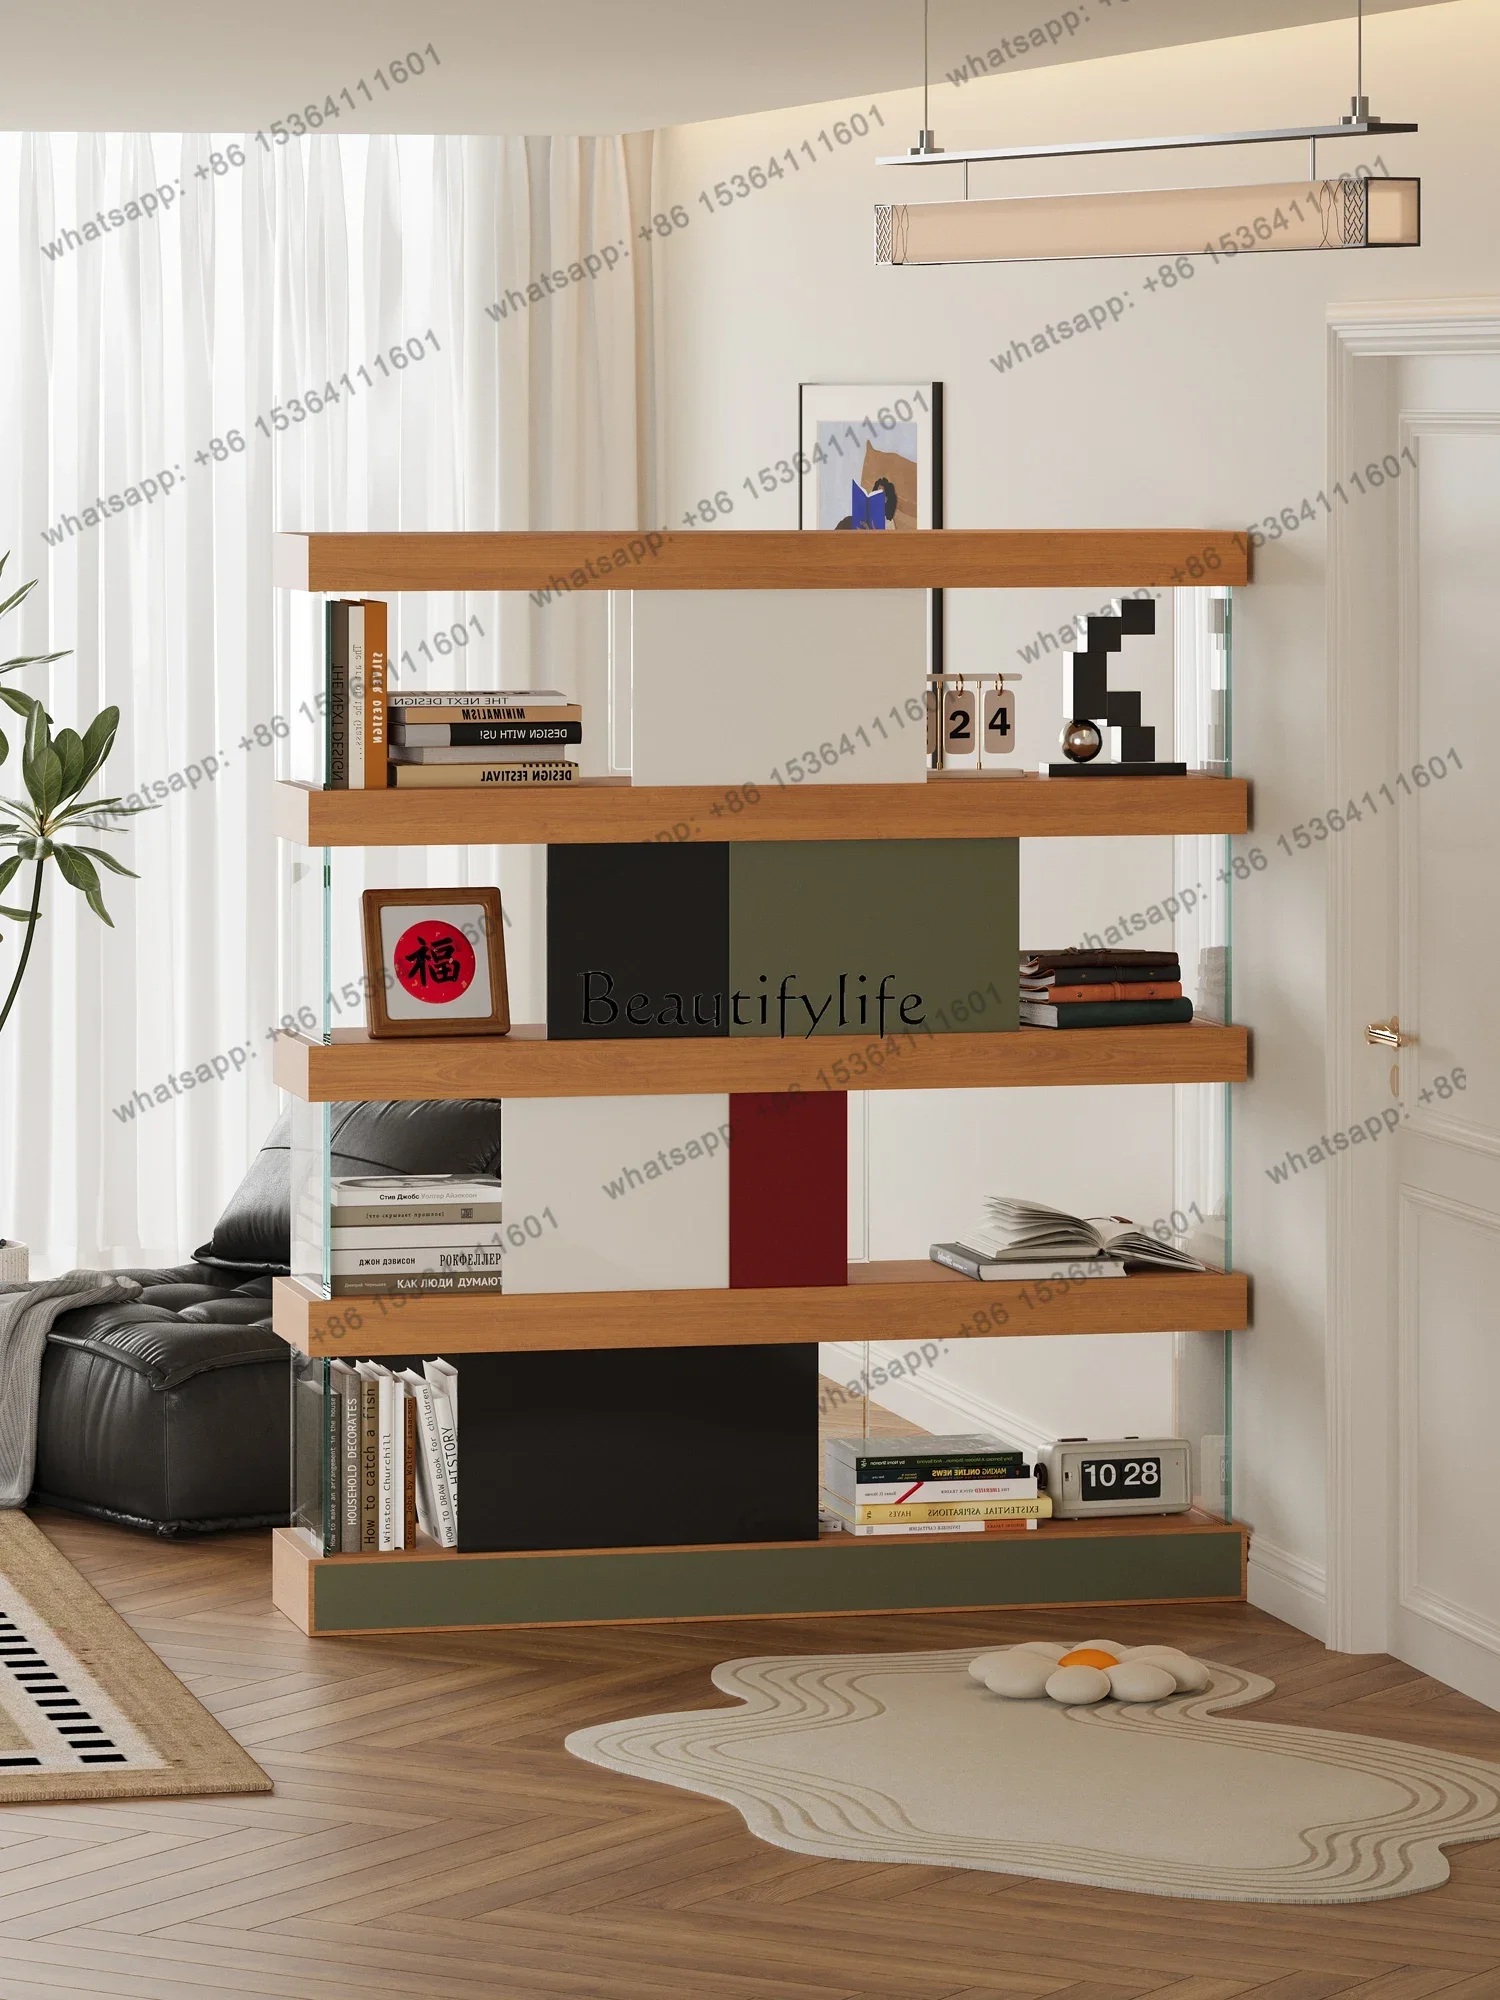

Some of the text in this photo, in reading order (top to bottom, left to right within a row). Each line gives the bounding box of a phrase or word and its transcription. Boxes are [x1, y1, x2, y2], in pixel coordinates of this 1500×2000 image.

[949, 707, 1011, 739] 2 4
[404, 935, 461, 987] 福
[359, 1253, 501, 1267] ДЖОН ДЭВИСОН РОКФЕЛЛЕР
[397, 1279, 418, 1288] КАК
[420, 1278, 454, 1289] ЛЮДИ
[347, 1398, 358, 1525] HOUSEHOLD DECORATES
[362, 1388, 376, 1544] How to catch a fish
[405, 1445, 413, 1475] Walter
[423, 1388, 454, 1543] HOW TO DRAW Book for children
[1084, 1462, 1159, 1488] 10 28
[383, 1433, 391, 1543] Winston Churchill
[405, 1480, 414, 1490] by
[405, 1495, 413, 1515] Jobs
